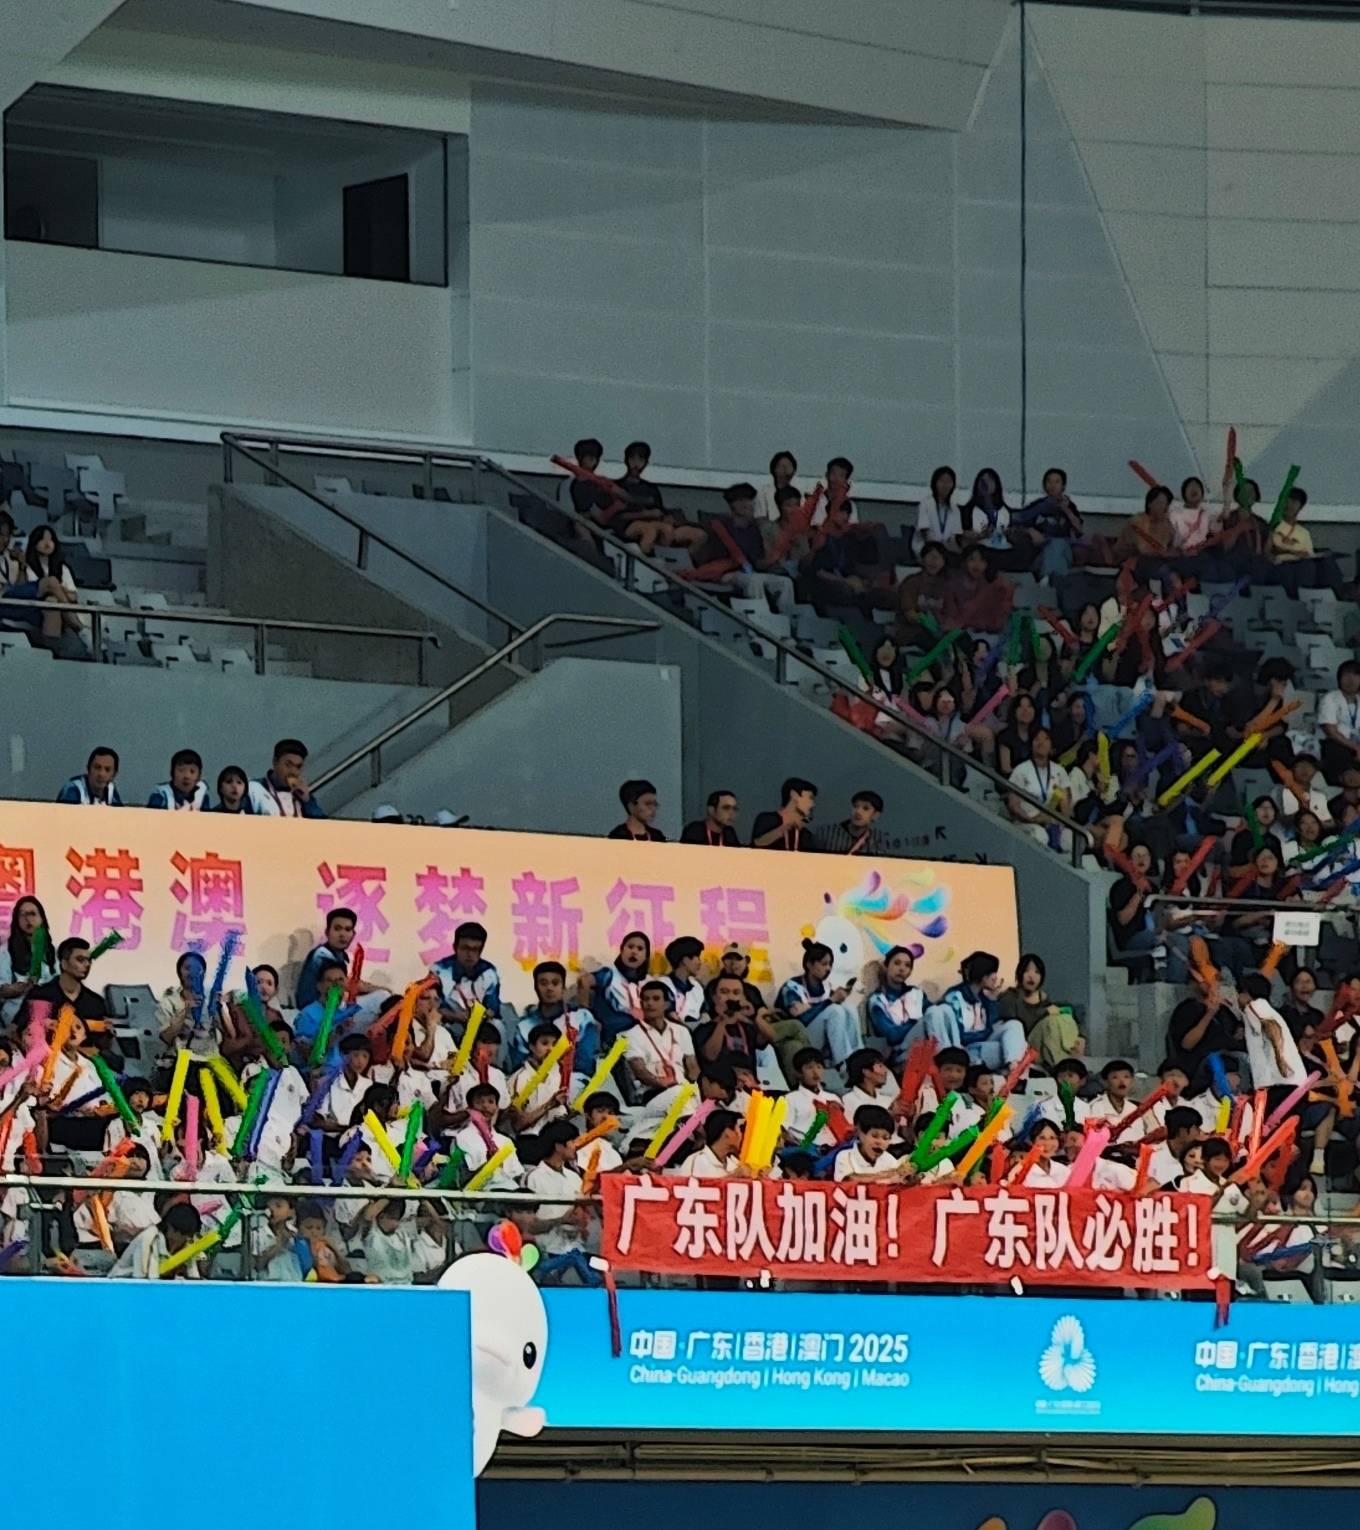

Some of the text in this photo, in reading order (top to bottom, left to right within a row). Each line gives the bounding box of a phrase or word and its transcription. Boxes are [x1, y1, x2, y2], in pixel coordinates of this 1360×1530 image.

[317, 861, 773, 984] 逐梦新征程
[849, 1334, 910, 1362] 2025
[773, 1369, 811, 1390] Hong
[814, 1369, 852, 1390] Kong
[862, 1369, 910, 1387] Macao
